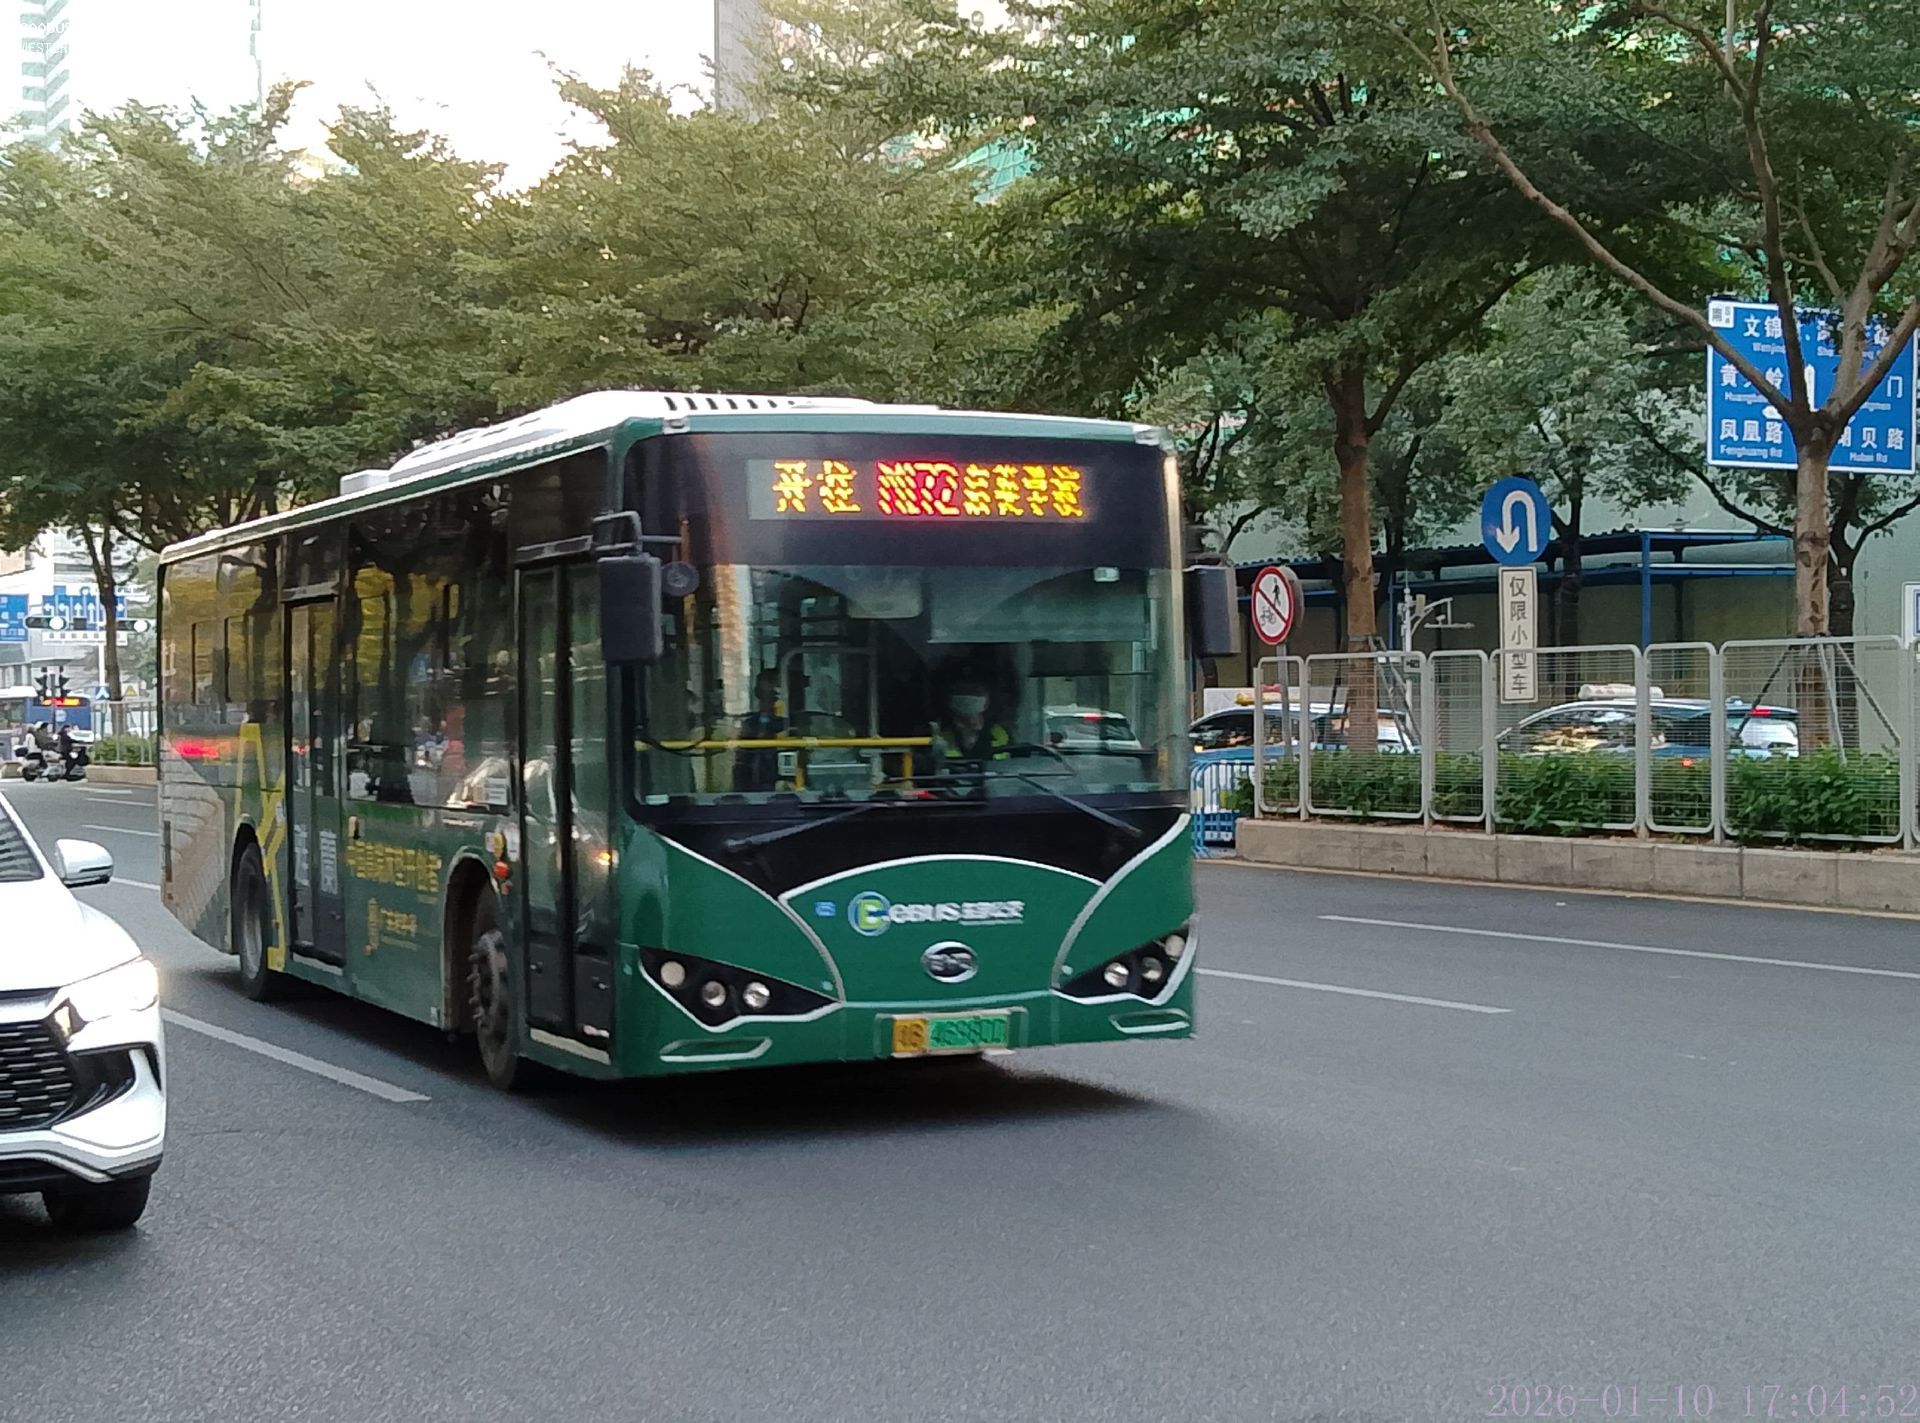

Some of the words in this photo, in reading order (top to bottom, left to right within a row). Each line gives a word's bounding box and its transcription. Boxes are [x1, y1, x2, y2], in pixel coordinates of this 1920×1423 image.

[1720, 364, 1784, 391] 黄岭
[1720, 418, 1783, 444] 凤凰路
[1509, 575, 1528, 695] 仅限小型车
